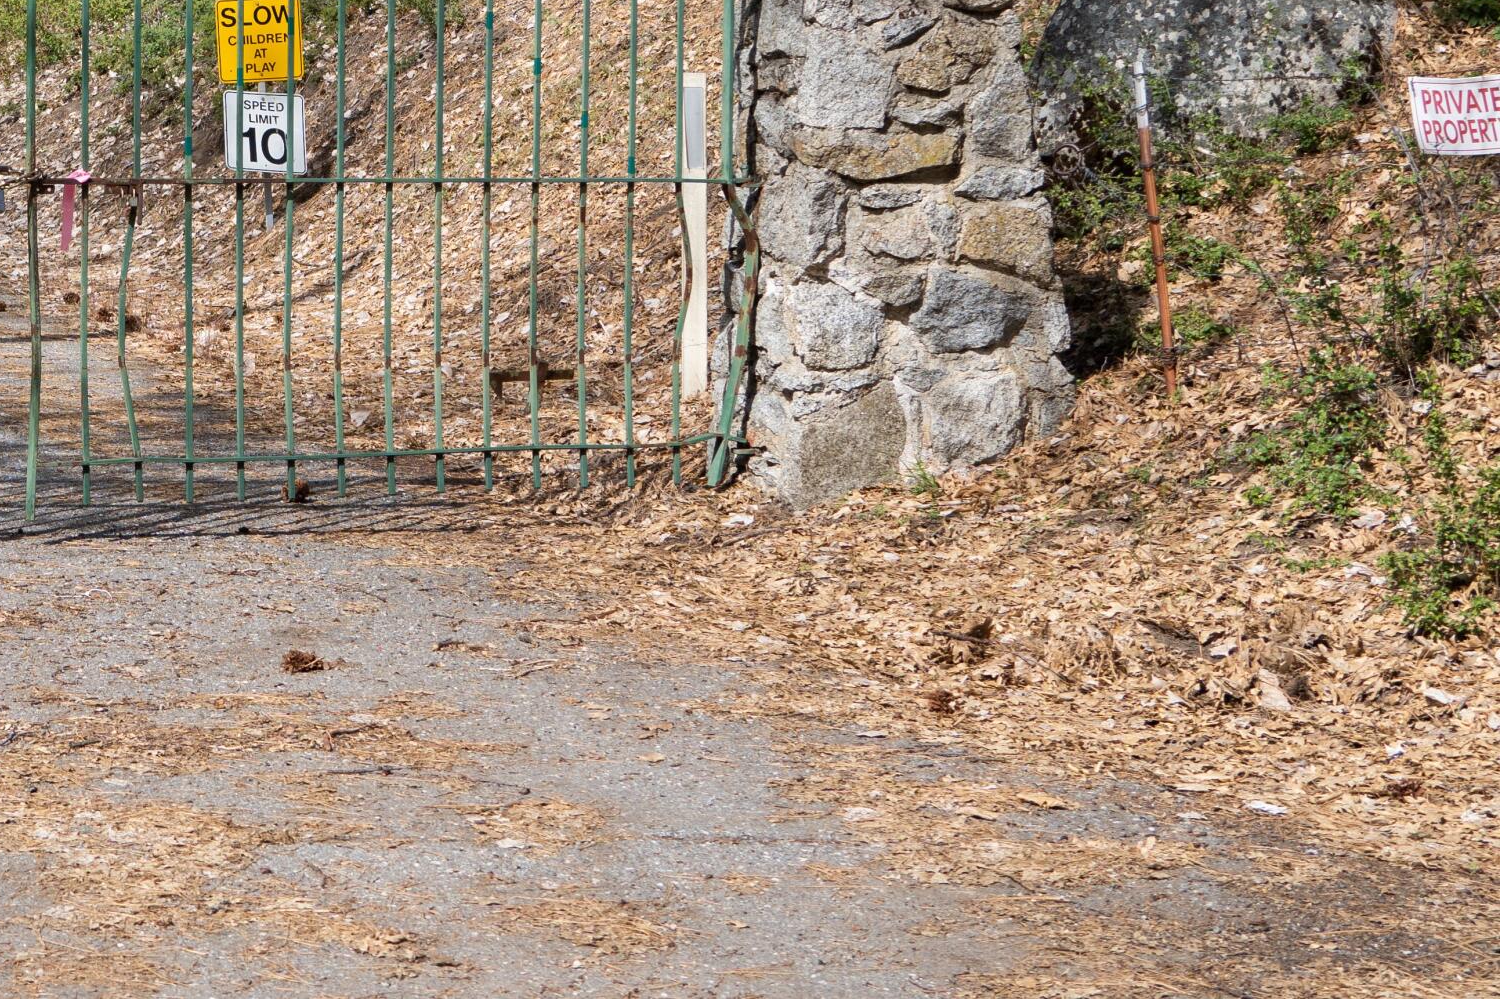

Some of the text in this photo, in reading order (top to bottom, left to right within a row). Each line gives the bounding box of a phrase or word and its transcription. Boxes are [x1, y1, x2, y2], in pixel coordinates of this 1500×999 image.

[228, 32, 289, 46] CILDREN
[254, 48, 268, 59] AT
[245, 62, 277, 74] PLAY
[243, 100, 284, 112] SPEED
[1421, 86, 1500, 114] PRIVATE
[248, 114, 280, 125] LIMIT
[1422, 117, 1500, 144] PROPERT
[242, 127, 288, 165] 10
